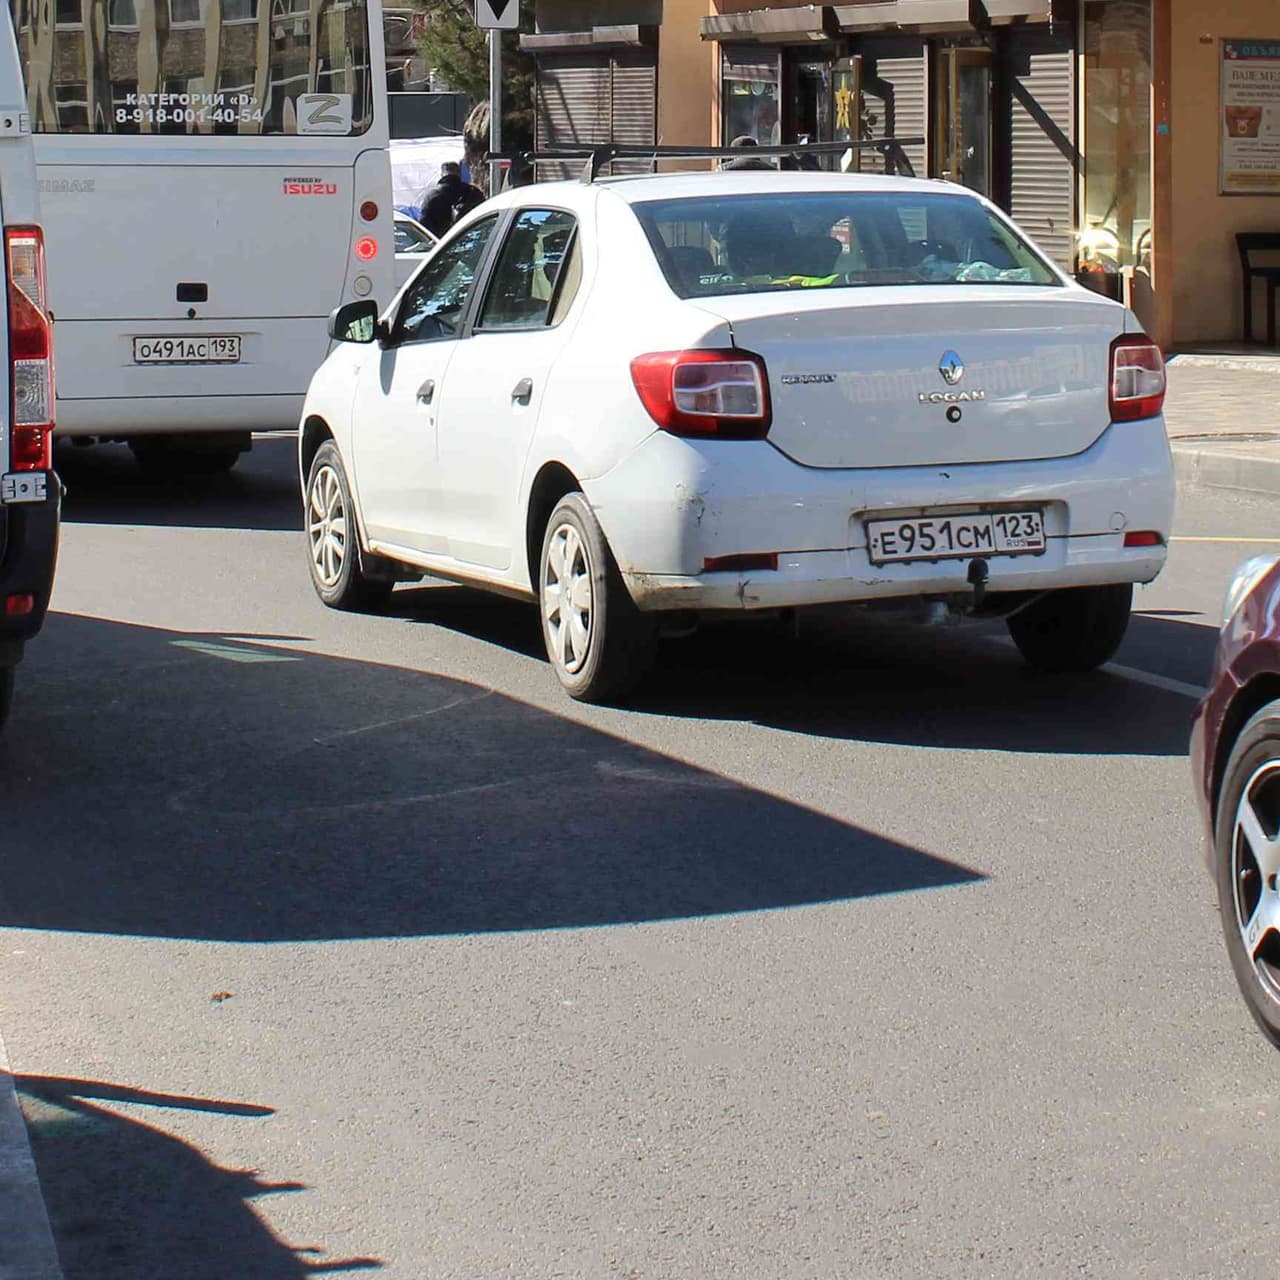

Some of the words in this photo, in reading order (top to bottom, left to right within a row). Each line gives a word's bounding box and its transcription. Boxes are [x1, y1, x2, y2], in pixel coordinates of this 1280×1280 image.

[125, 93, 225, 107] КАТЕГОРИИ
[115, 108, 264, 124] 8-918-001-40-54
[304, 94, 345, 125] Z
[283, 183, 337, 195] ISUZU
[211, 339, 236, 353] 193
[919, 391, 985, 404] LOGAN
[995, 514, 1035, 539] 123
[1006, 538, 1028, 547] RUS
